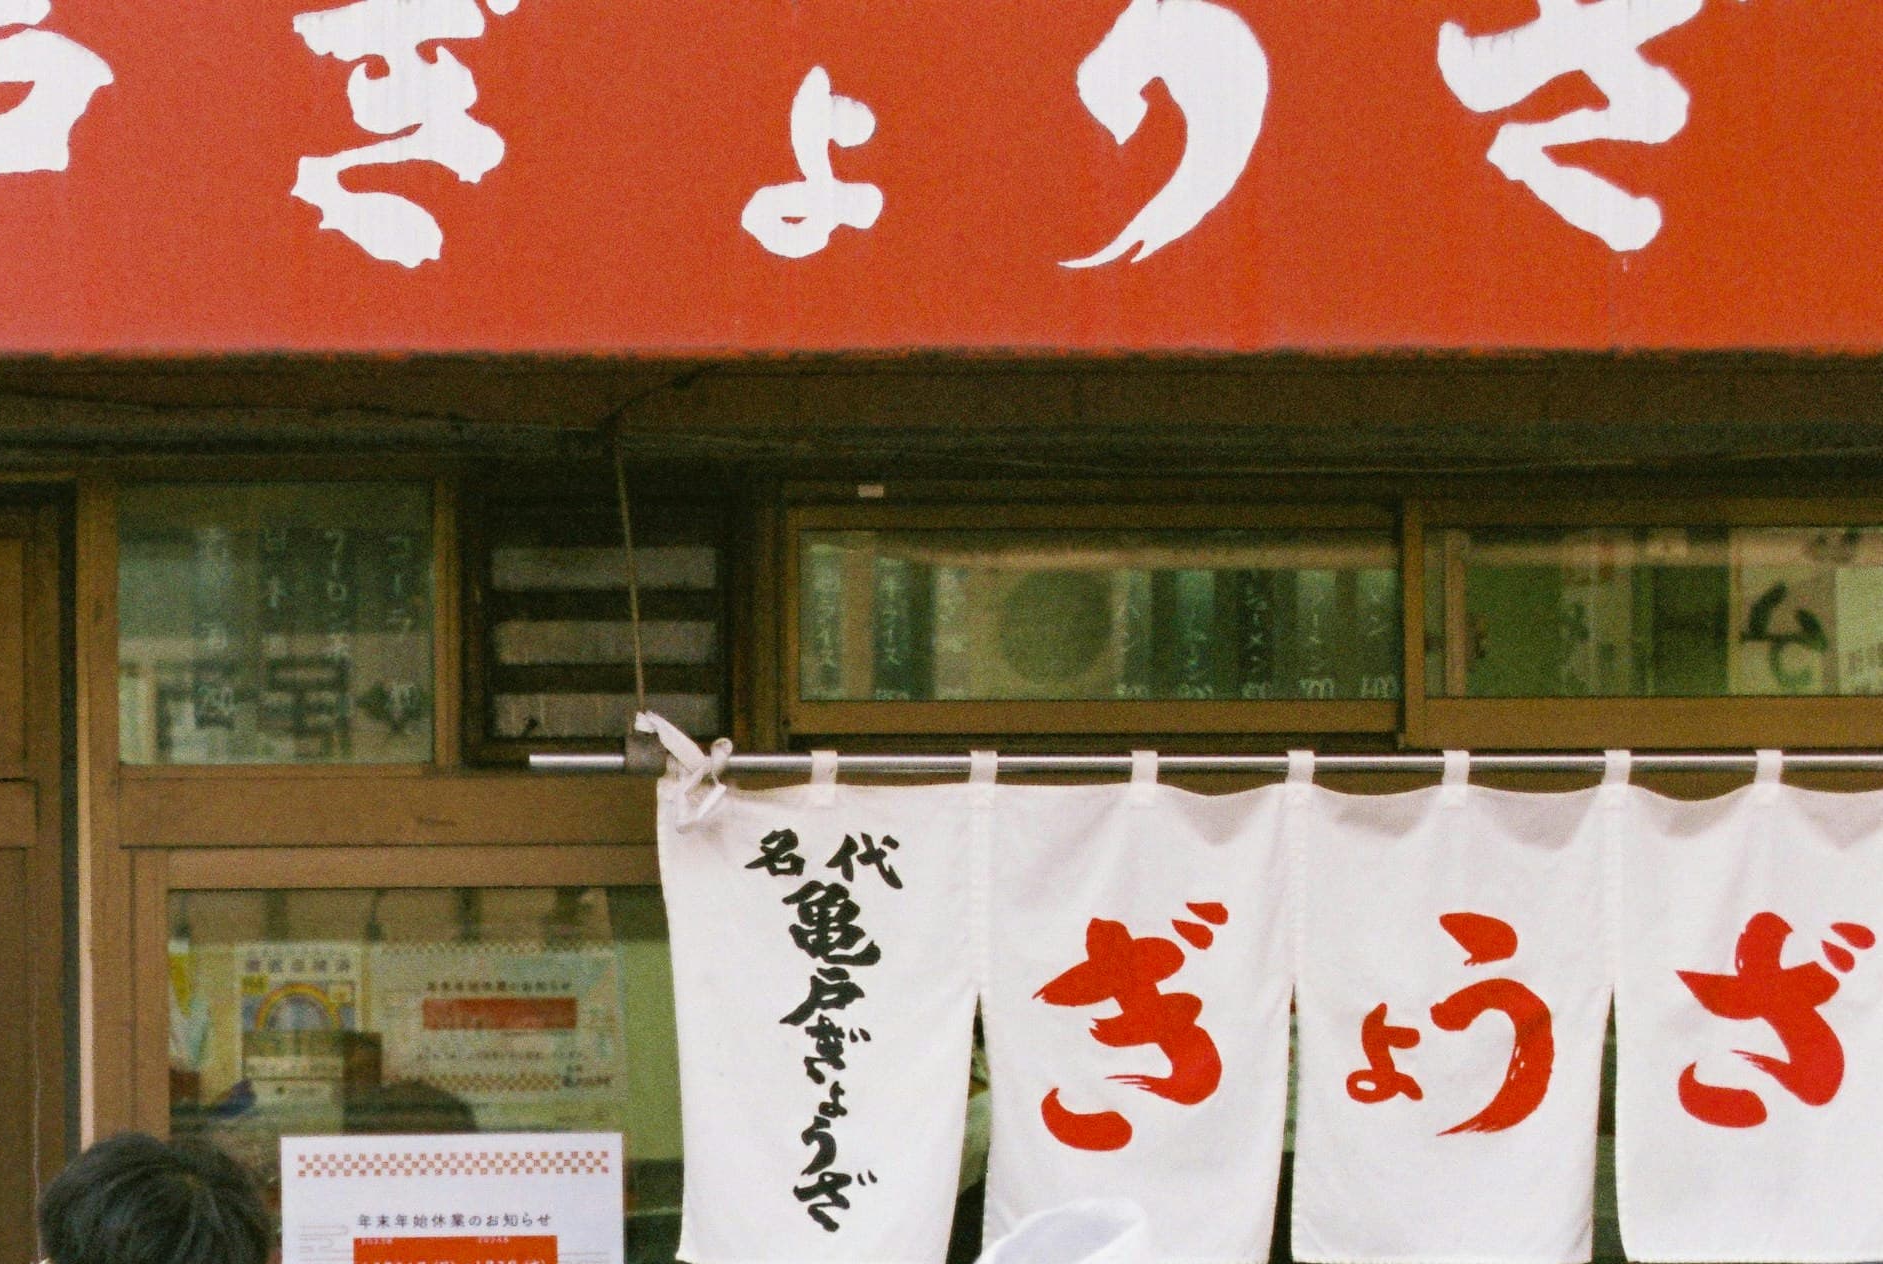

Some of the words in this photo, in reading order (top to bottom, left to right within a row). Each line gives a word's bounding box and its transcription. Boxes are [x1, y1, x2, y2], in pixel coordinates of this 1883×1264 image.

[745, 828, 904, 889] 名代
[780, 879, 882, 1233] 亀戸ぎょうざ
[1032, 901, 1878, 1152] ぎょうざ
[358, 1214, 551, 1228] 年末年始休業のお知らせ
